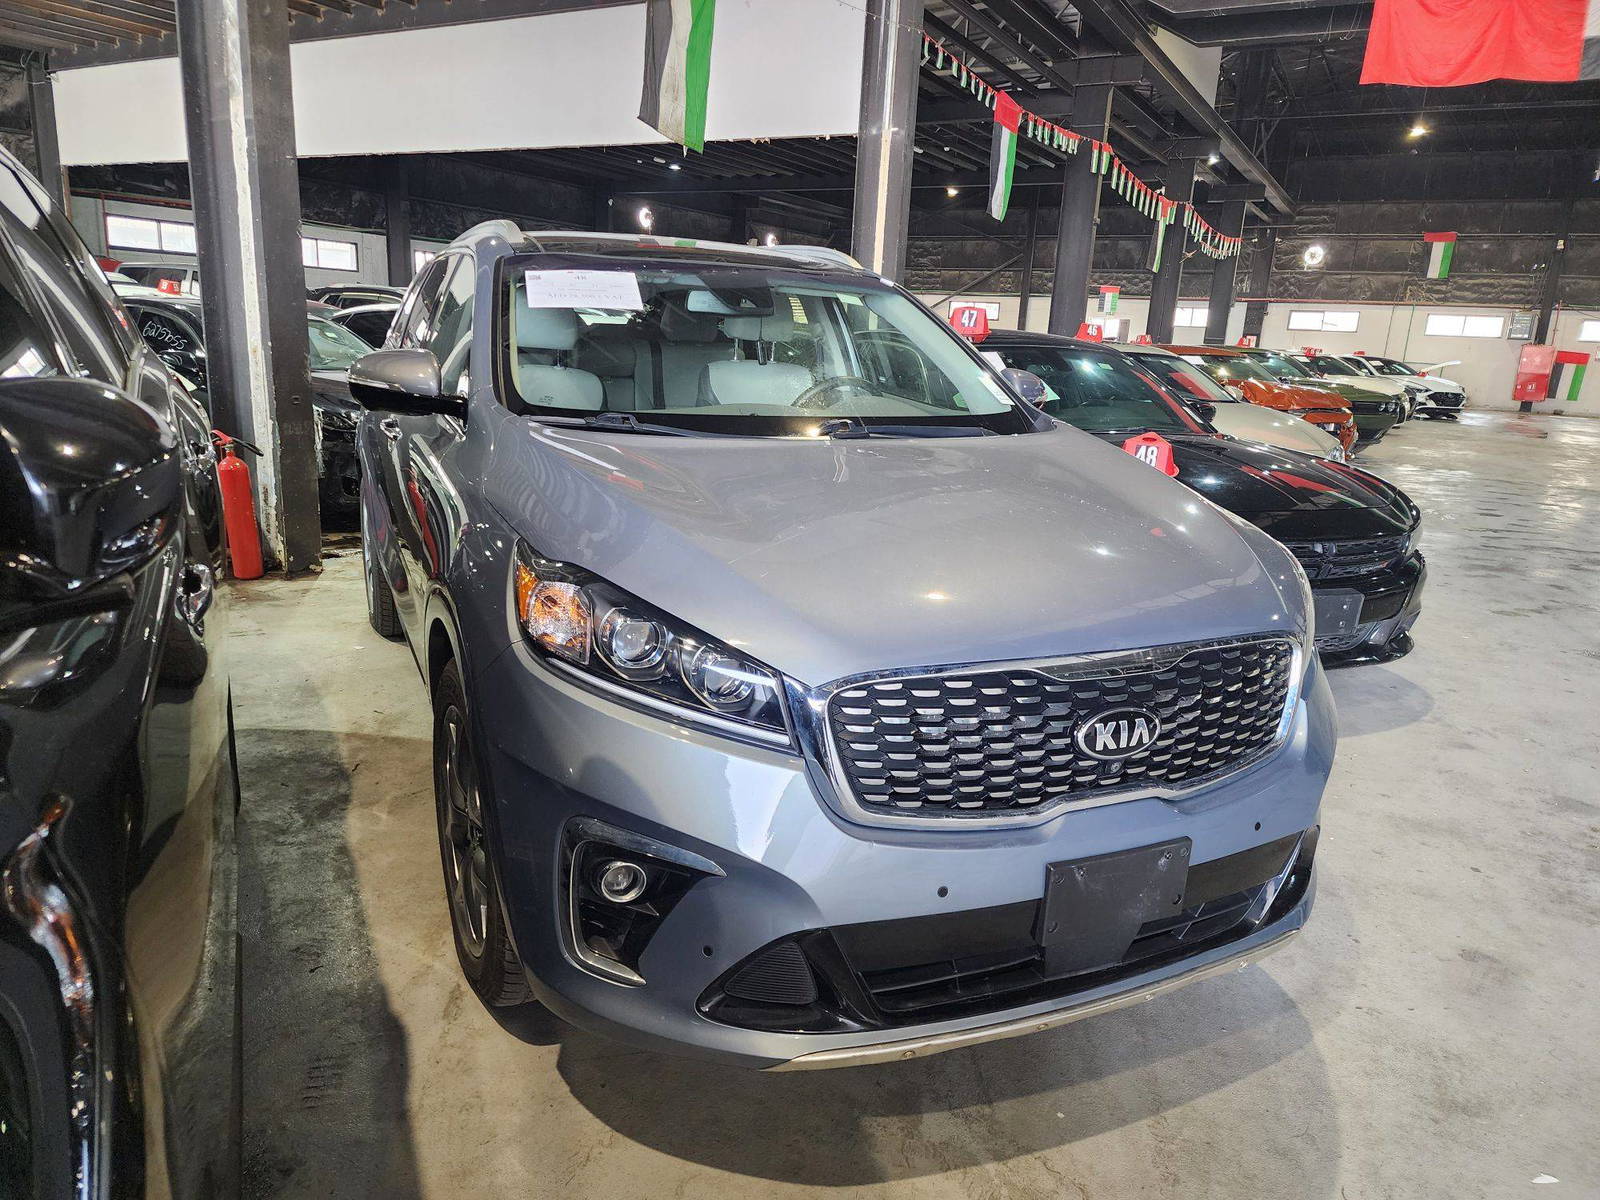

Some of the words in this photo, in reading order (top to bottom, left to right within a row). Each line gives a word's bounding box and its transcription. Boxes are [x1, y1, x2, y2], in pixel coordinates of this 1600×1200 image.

[961, 310, 978, 327] 47
[1087, 324, 1098, 336] 46
[1135, 445, 1158, 467] 48
[1095, 717, 1150, 751] KIA
